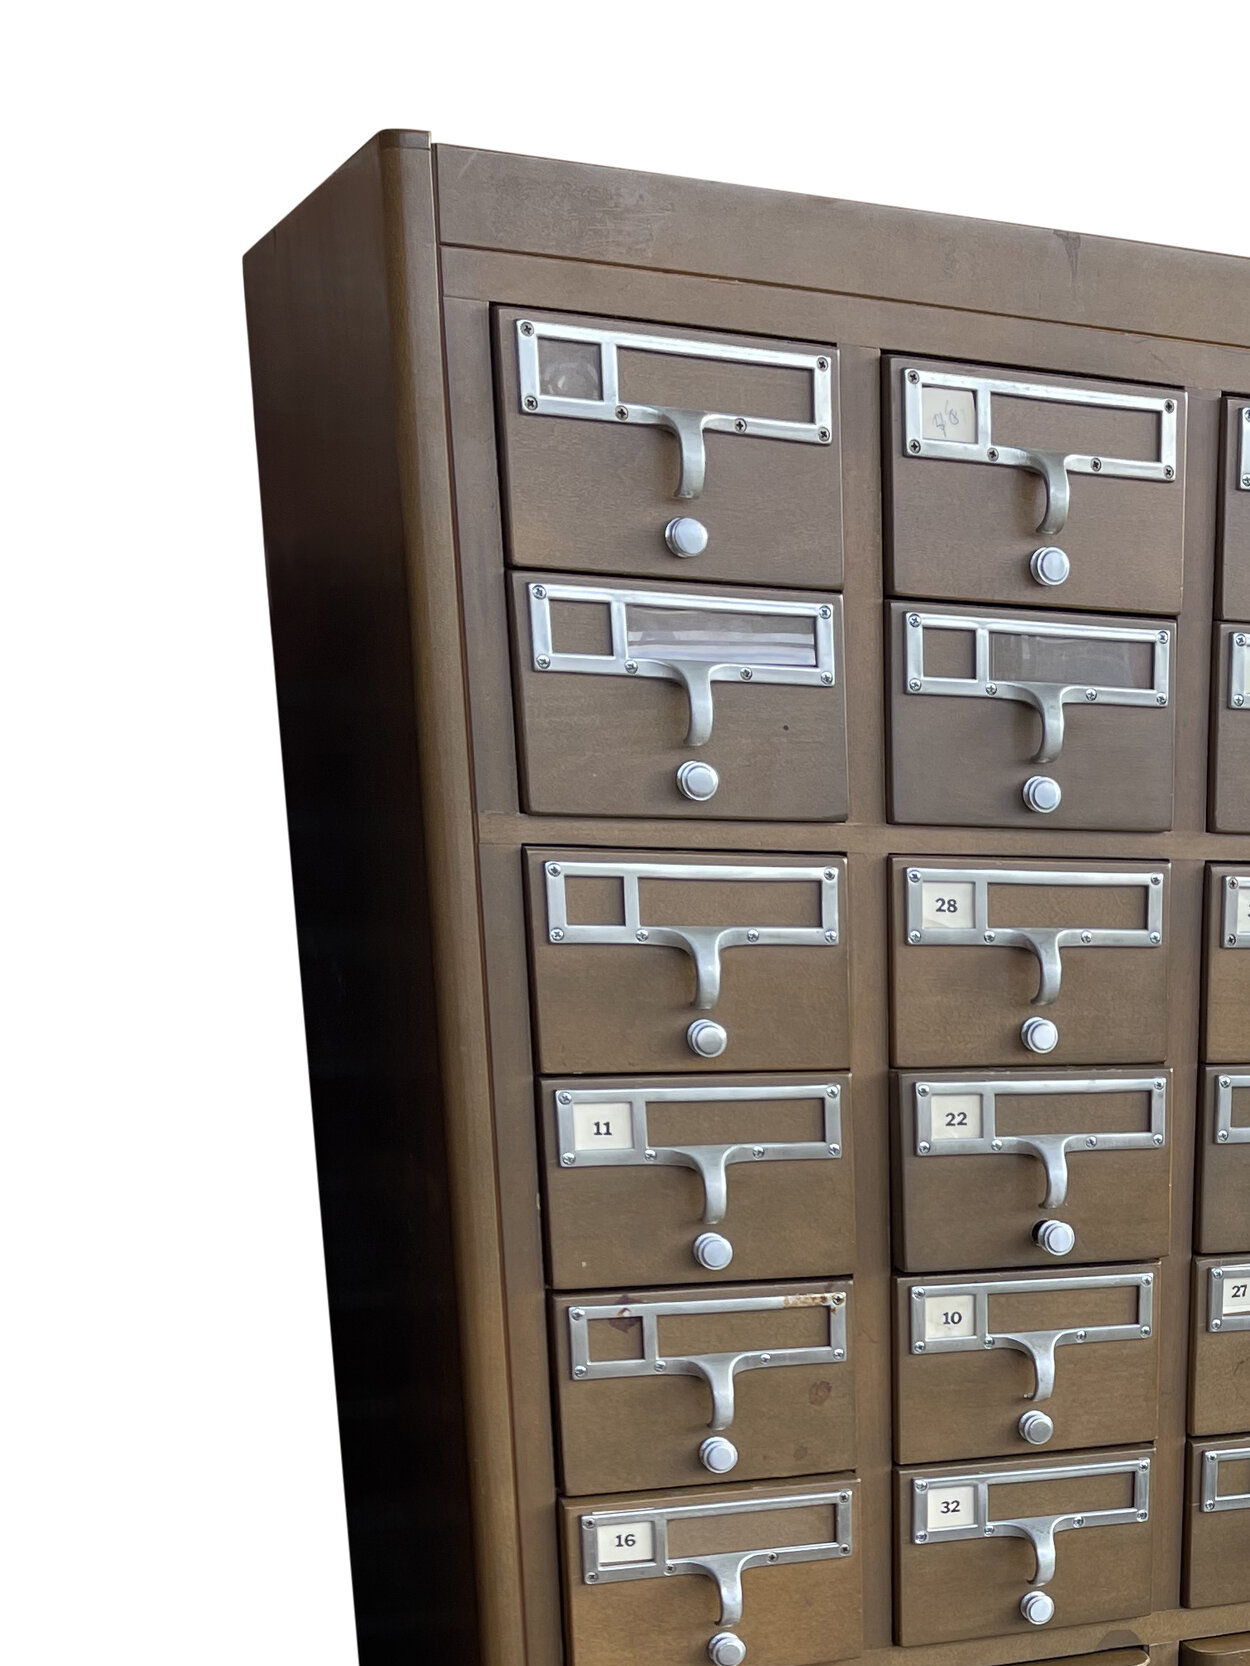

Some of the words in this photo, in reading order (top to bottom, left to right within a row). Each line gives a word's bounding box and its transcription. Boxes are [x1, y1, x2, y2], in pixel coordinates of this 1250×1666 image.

[935, 897, 958, 914] 28
[945, 1111, 968, 1127] 22
[594, 1121, 613, 1136] 11
[1231, 1284, 1248, 1298] 27
[943, 1311, 963, 1325] 10
[940, 1499, 961, 1514] 32
[615, 1533, 636, 1548] 16
